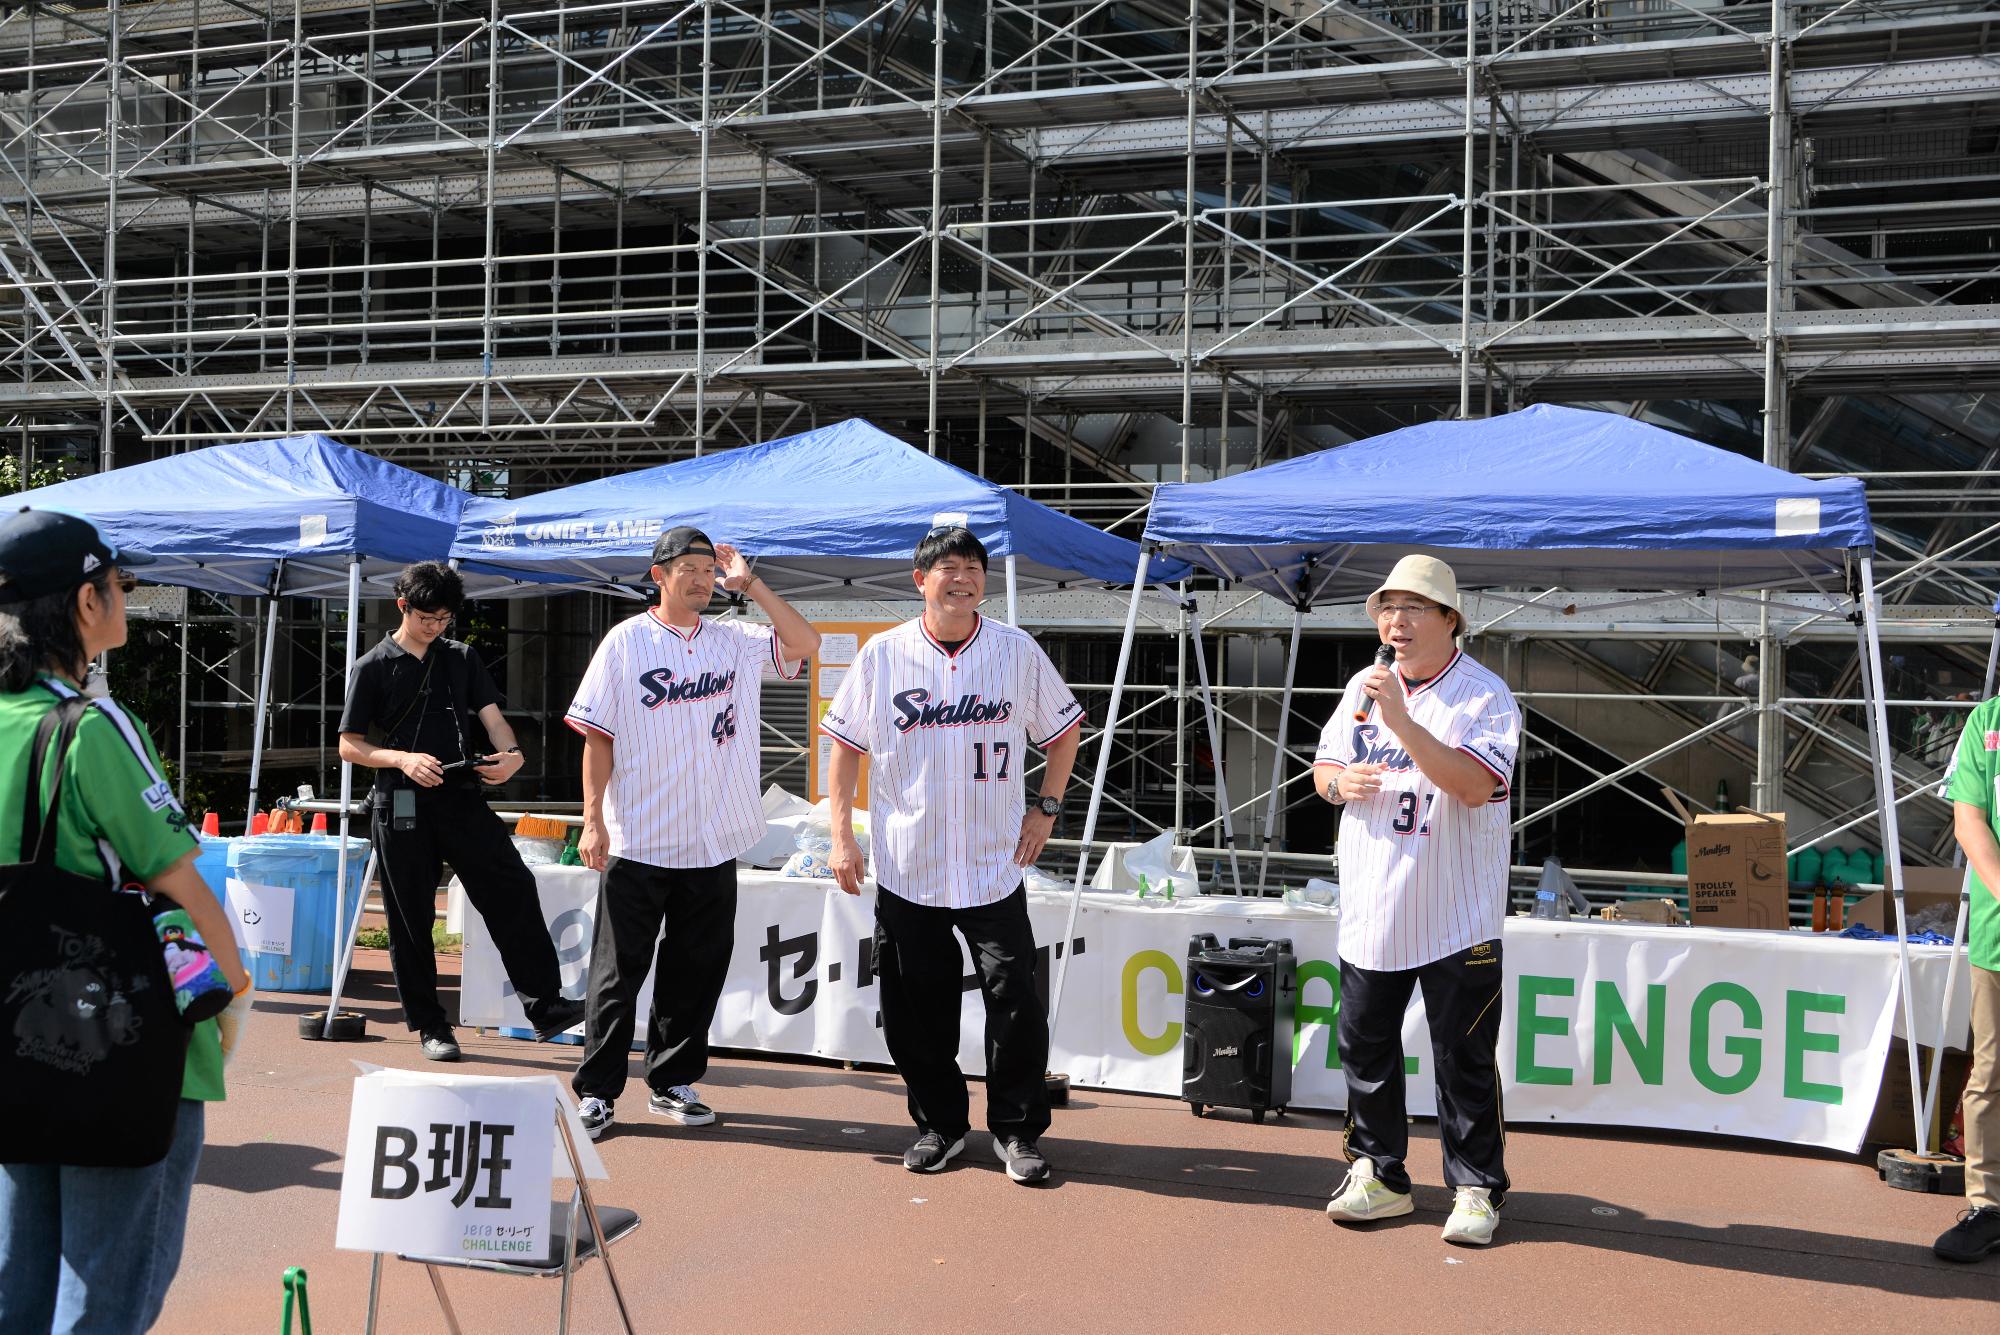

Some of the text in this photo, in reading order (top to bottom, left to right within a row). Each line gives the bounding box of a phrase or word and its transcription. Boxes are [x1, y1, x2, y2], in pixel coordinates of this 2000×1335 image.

[525, 519, 664, 541] UNIFLAME
[639, 667, 736, 710] Swallows
[892, 688, 1012, 733] Swallows
[973, 741, 1010, 782] 17
[1695, 882, 1734, 890] TROLLEY
[1695, 890, 1737, 898] SPEAKER
[371, 1121, 515, 1209] B班
[462, 1238, 533, 1252] CHALLENGE
